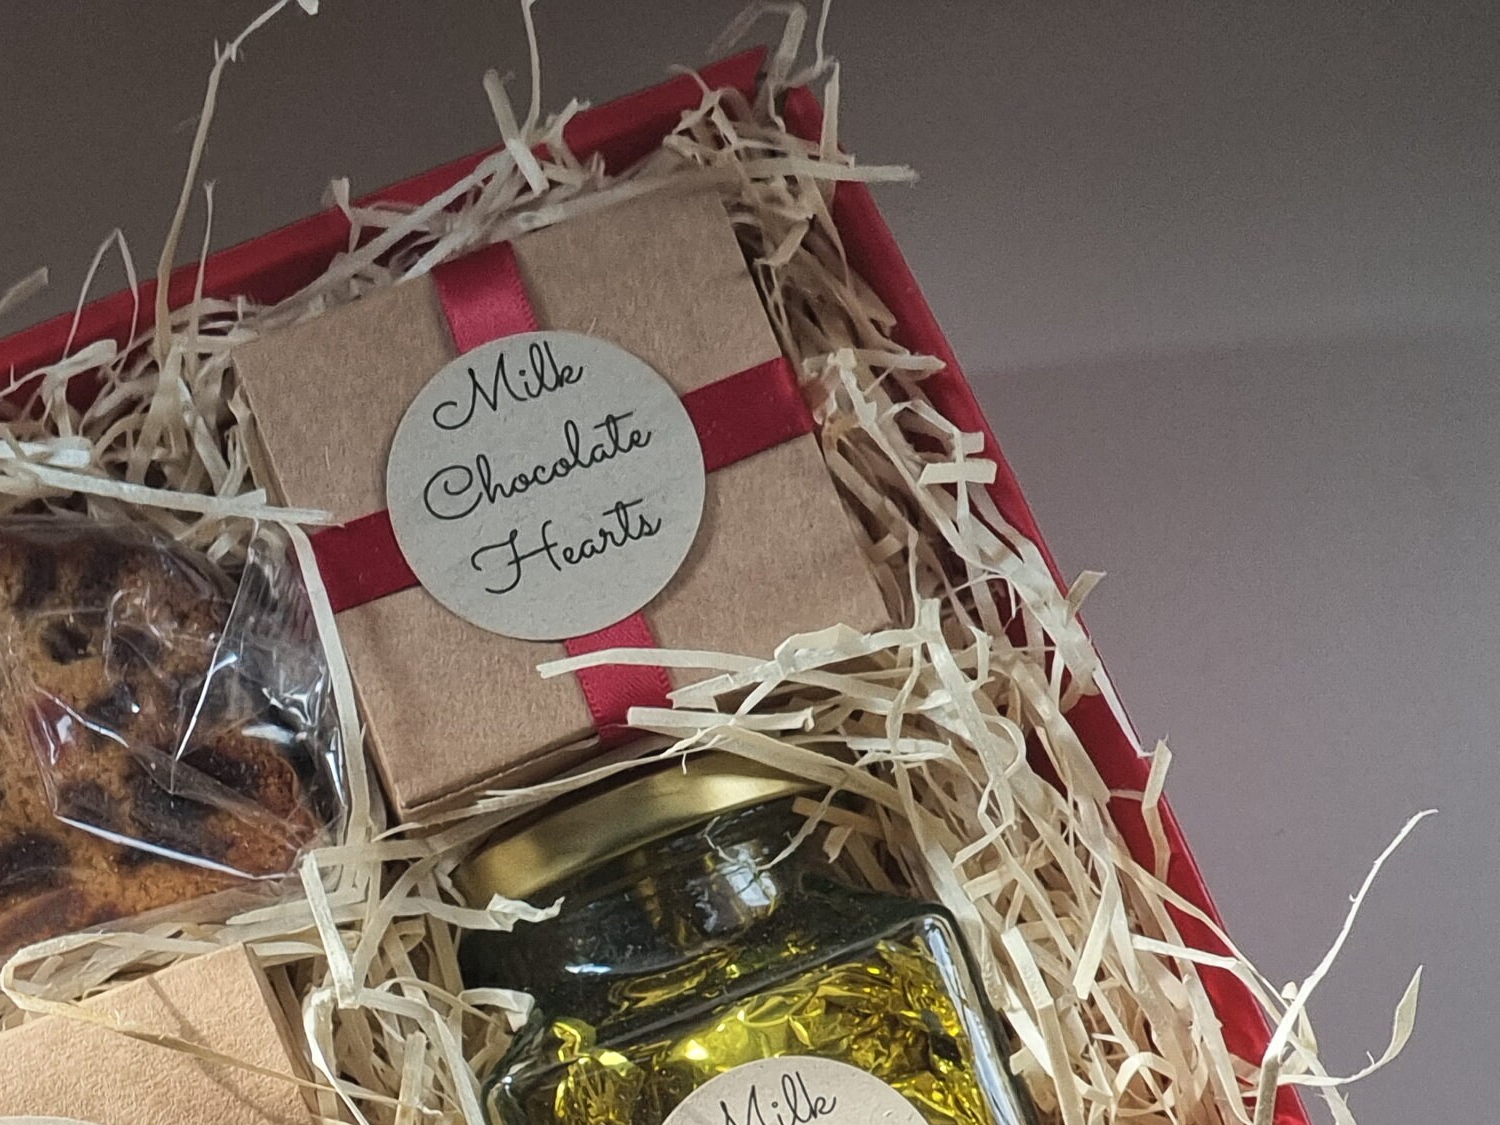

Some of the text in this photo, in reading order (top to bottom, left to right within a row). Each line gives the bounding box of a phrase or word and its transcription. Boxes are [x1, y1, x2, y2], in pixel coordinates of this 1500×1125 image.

[431, 339, 584, 430] Milk
[423, 410, 653, 521] Chocolate
[470, 498, 662, 595] Hearts
